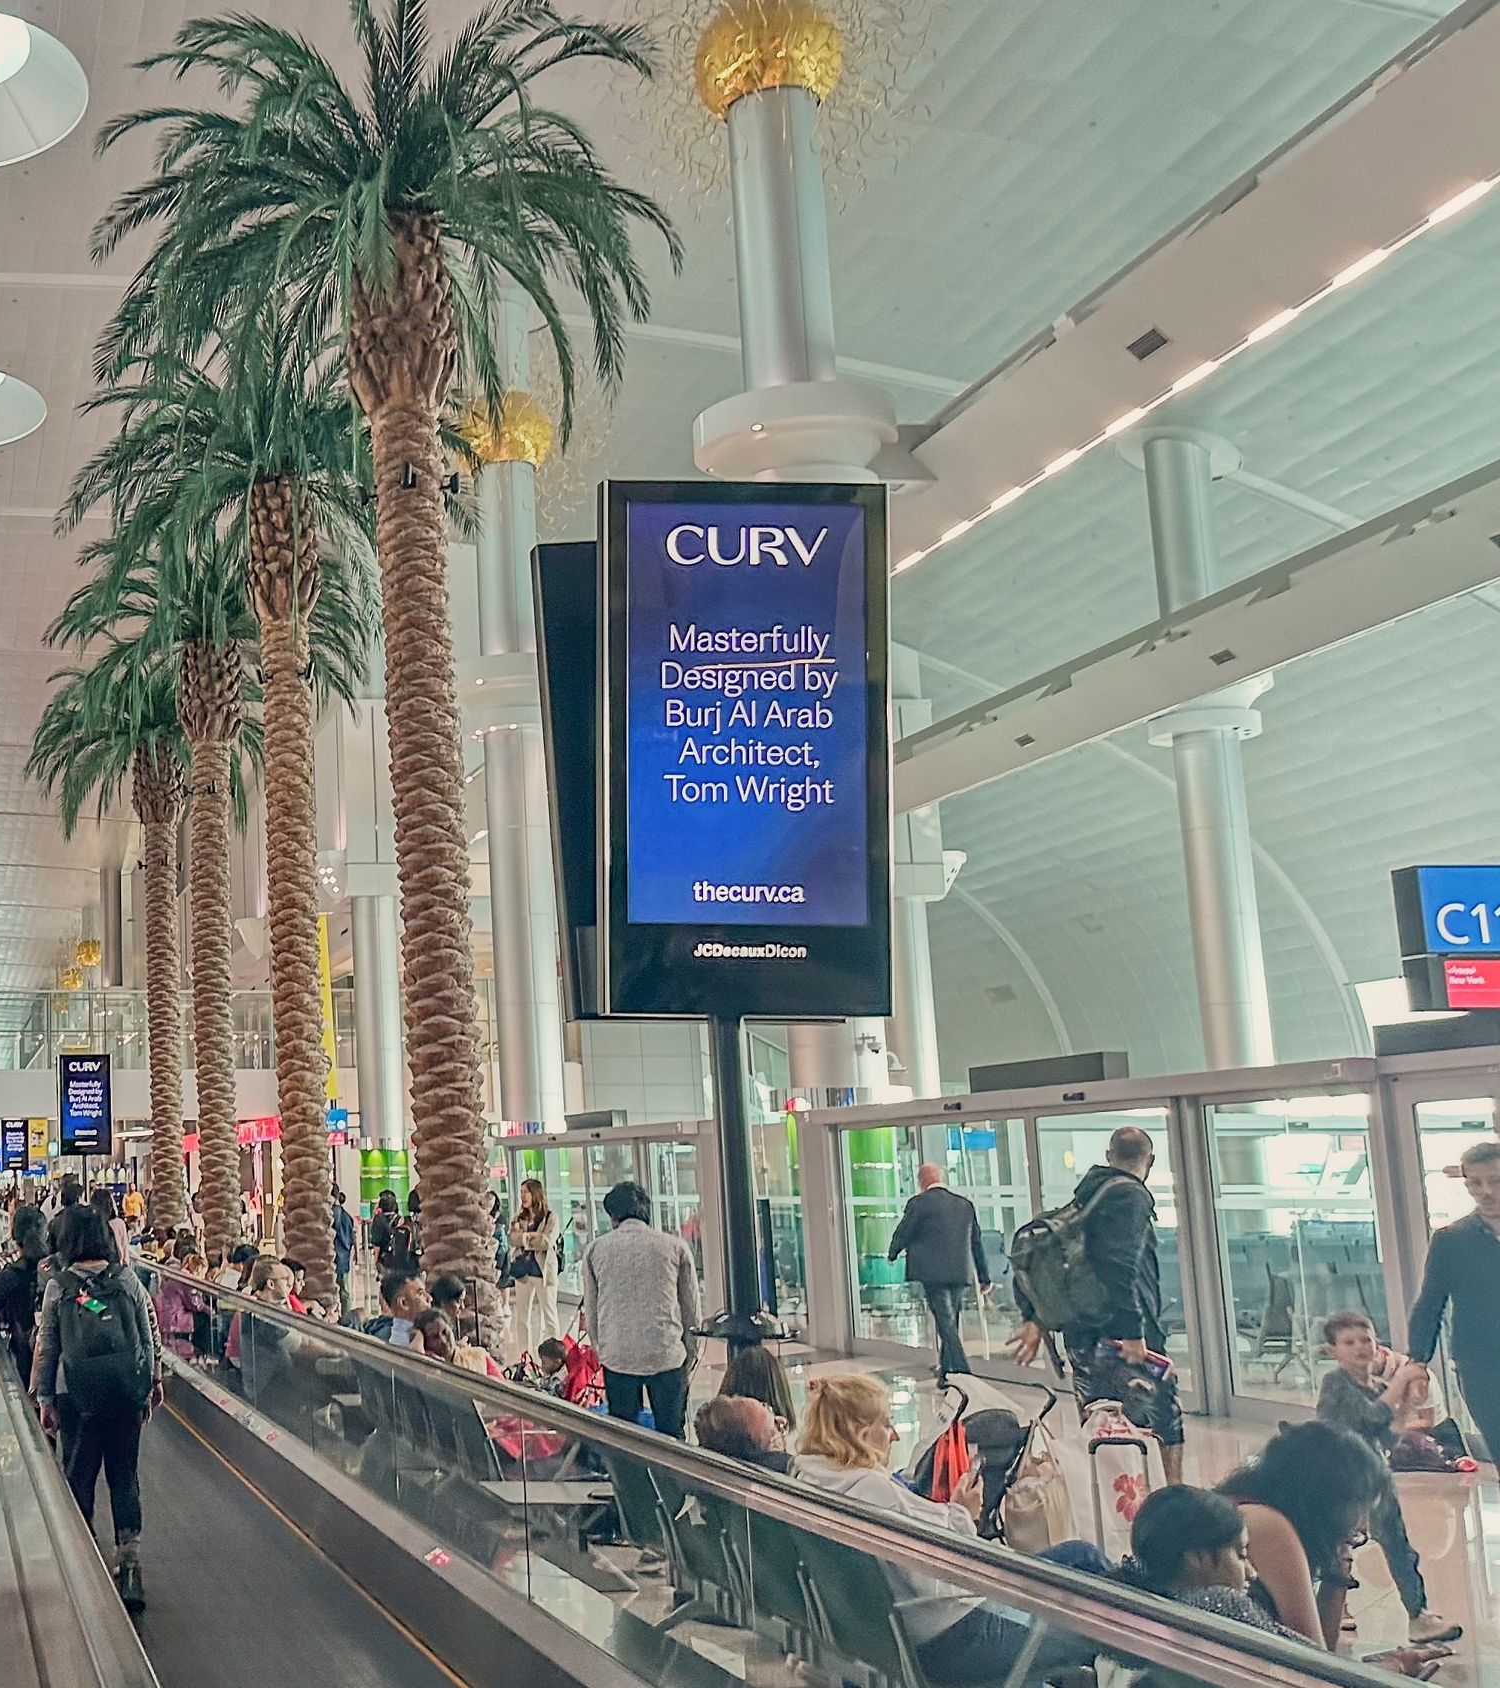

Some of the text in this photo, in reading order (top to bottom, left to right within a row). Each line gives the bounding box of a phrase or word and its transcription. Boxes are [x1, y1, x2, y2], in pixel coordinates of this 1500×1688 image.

[666, 525, 828, 566] CURV
[669, 623, 830, 660] Masterfully
[661, 661, 839, 698] Designed by
[666, 699, 833, 735] Burj Al Arab
[678, 737, 820, 769] Architect,
[663, 774, 835, 812] Tom Wright
[693, 880, 806, 903] thecurv.ca
[69, 1061, 100, 1072] CURV
